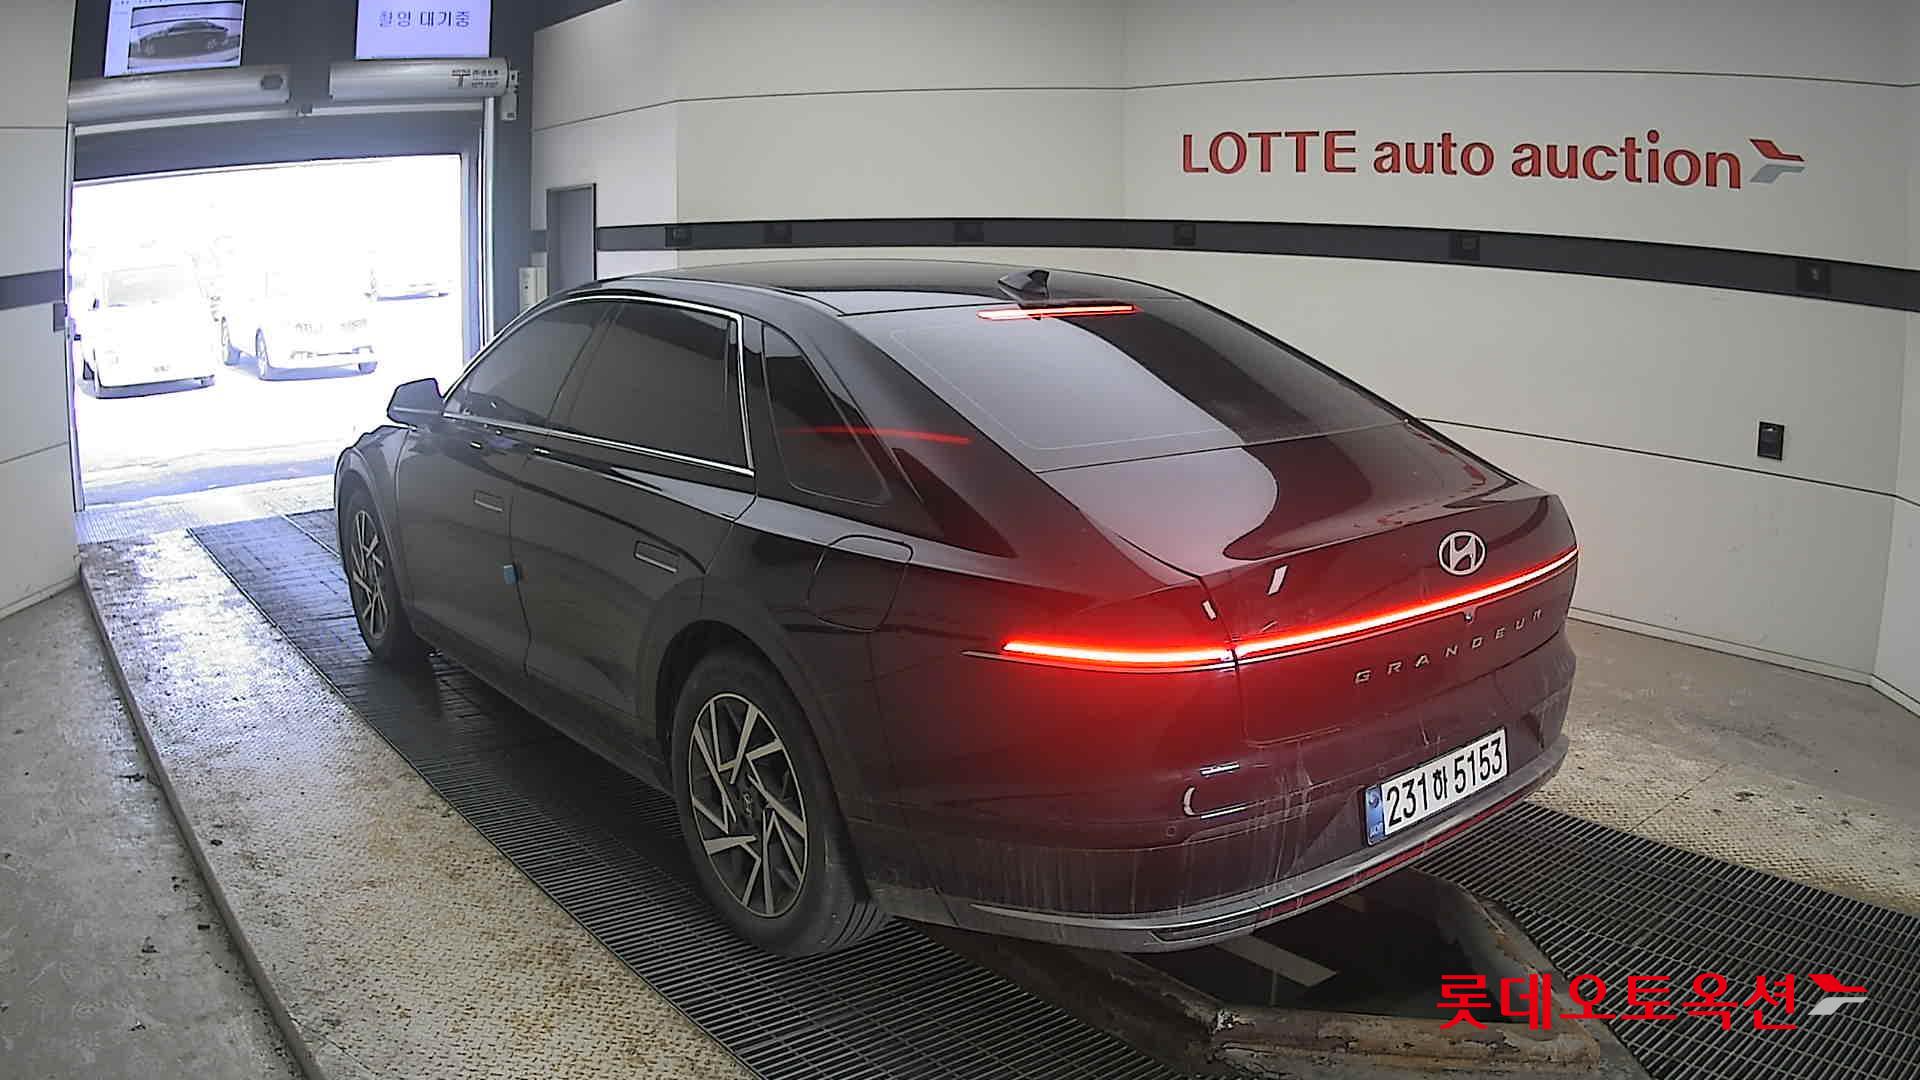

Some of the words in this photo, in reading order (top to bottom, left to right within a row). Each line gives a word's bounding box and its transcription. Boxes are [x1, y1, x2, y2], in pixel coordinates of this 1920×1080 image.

[420, 10, 470, 28] 대기중
[1183, 130, 1357, 174] LOTTE
[1372, 132, 1495, 177] auto
[1511, 130, 1741, 189] auction
[1354, 608, 1542, 684] GRANDEUR
